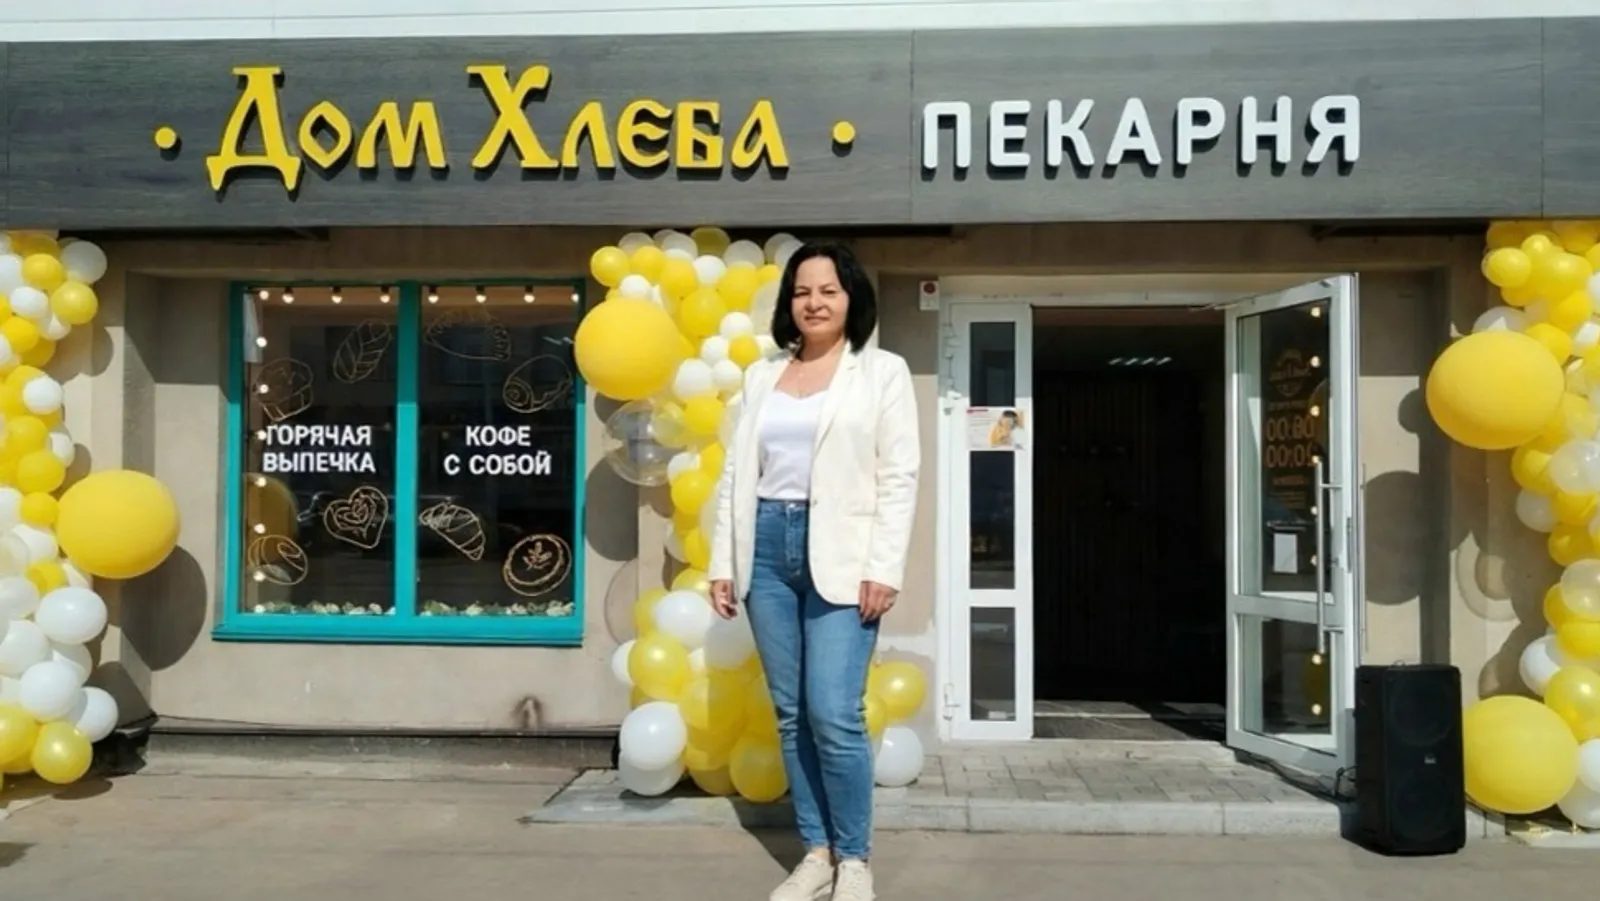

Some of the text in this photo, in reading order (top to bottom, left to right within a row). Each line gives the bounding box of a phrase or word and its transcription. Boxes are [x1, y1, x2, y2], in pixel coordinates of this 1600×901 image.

[205, 65, 446, 191] Дом
[921, 94, 1361, 169] ПЕКАРНЯ
[265, 425, 371, 446] ГОРЯЧАЯ
[466, 426, 531, 447] КОФЕ
[262, 453, 376, 475] ВЫПЕЧКА
[444, 451, 551, 476] С СОБОЙ
